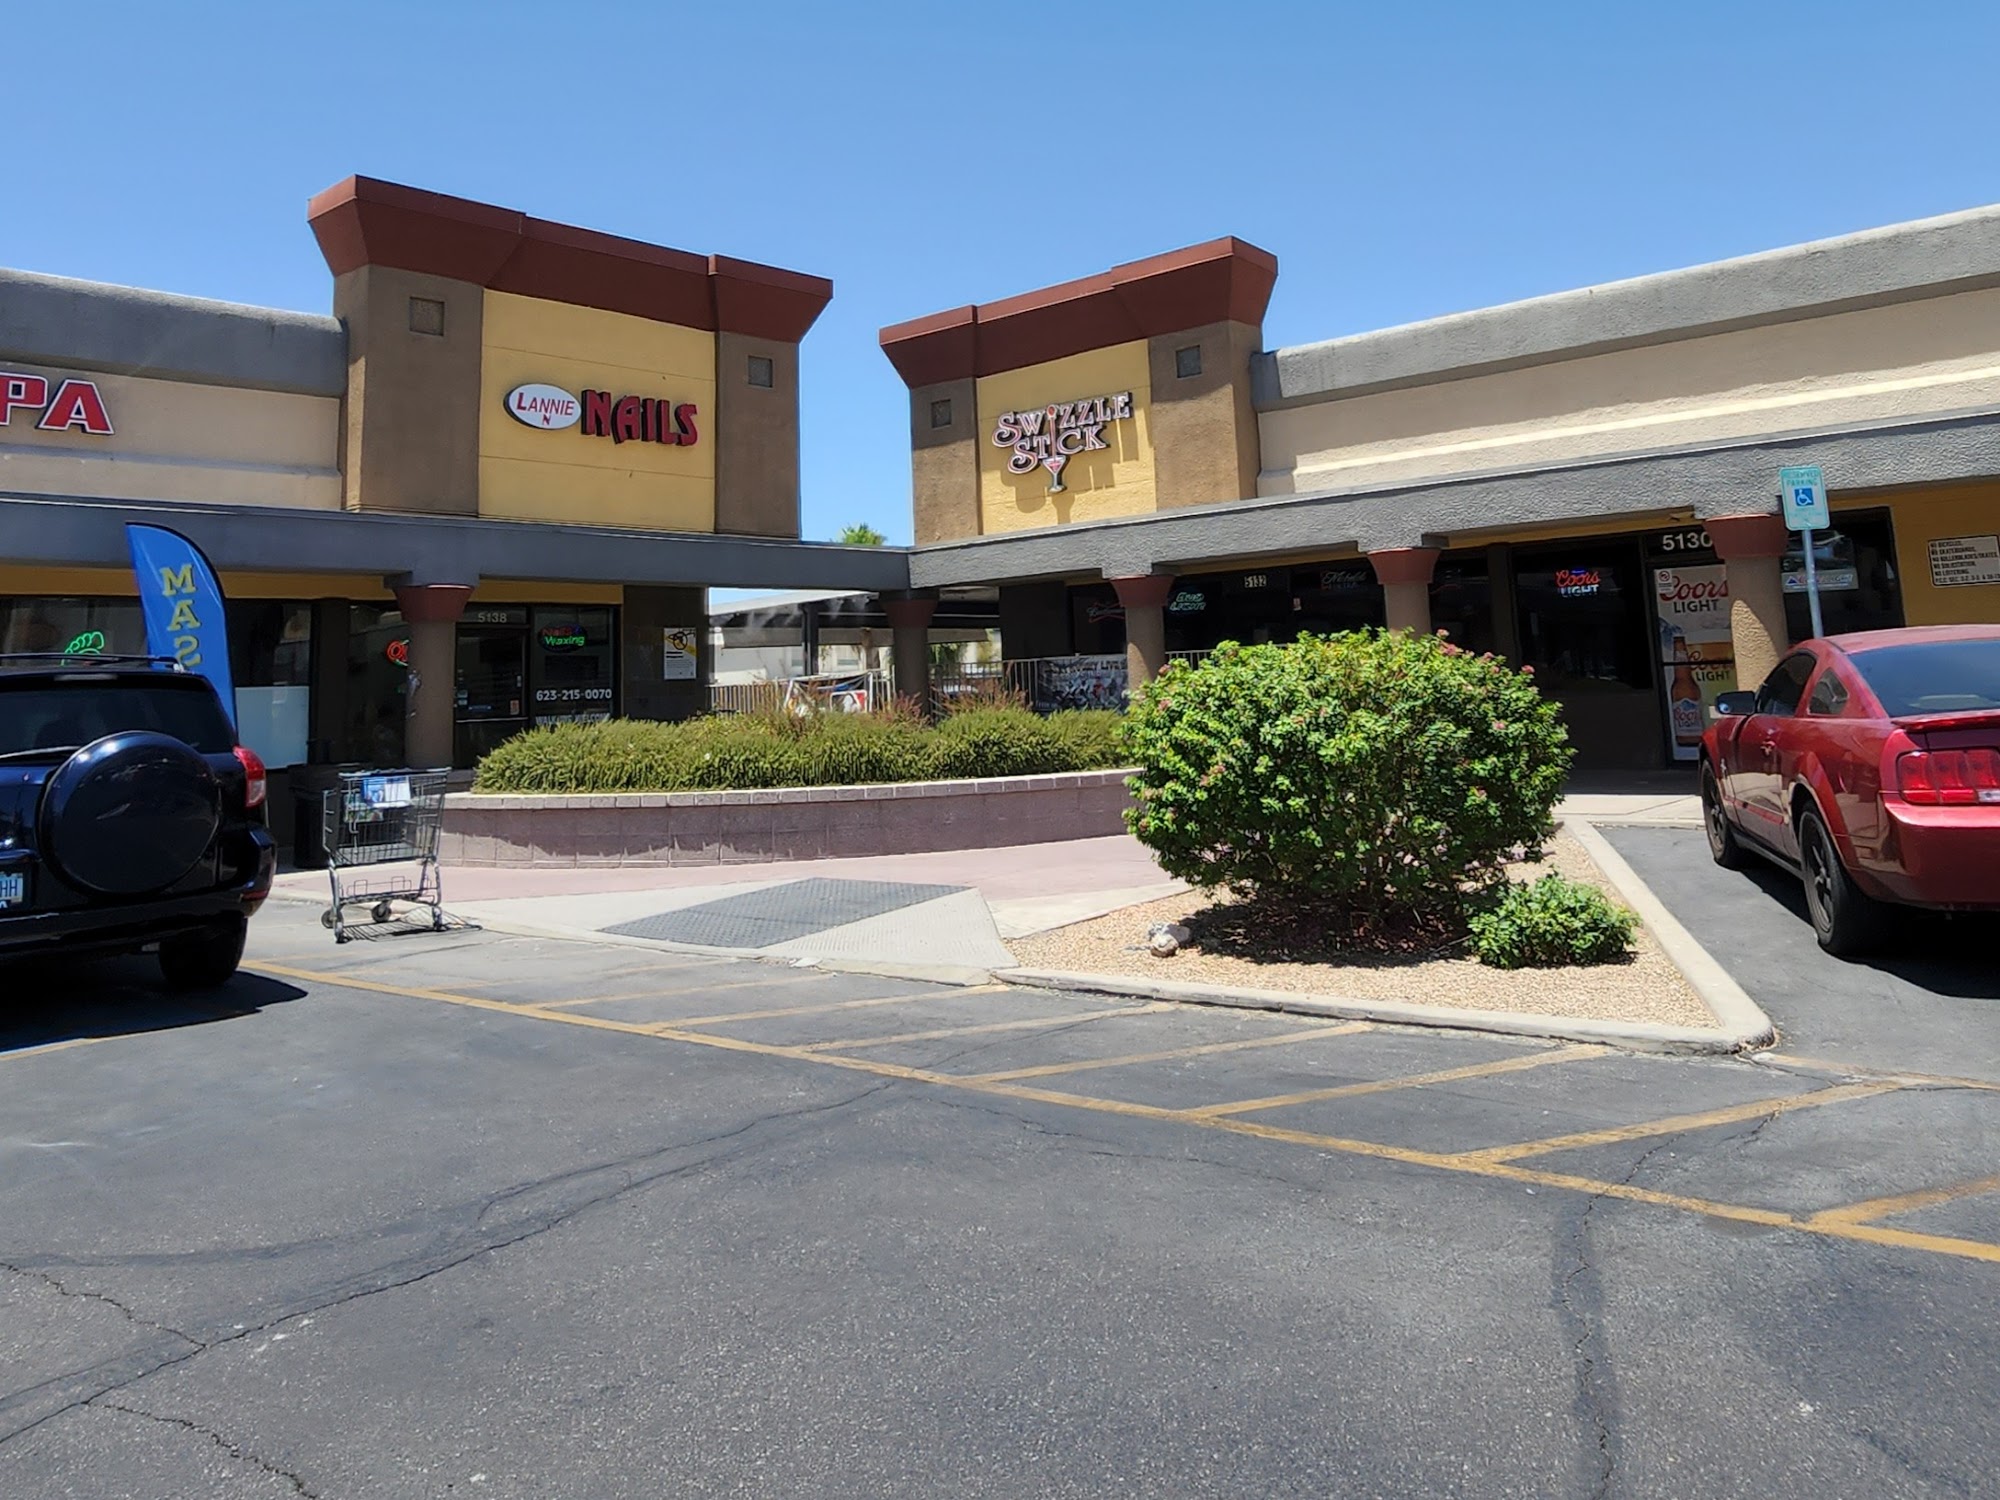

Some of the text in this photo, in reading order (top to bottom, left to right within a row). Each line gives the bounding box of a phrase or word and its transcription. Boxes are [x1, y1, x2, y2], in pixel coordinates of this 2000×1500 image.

[516, 392, 575, 416] LANNIE
[581, 389, 699, 446] NAILS
[992, 392, 1132, 447] SWIZZLE
[1007, 424, 1109, 474] STICK
[1662, 531, 1713, 551] 5130
[1556, 569, 1600, 587] Coors
[1660, 575, 1729, 602] Coors
[1673, 599, 1719, 613] LIGHT
[478, 612, 508, 624] 5138
[544, 635, 586, 647] Waxing
[1695, 670, 1731, 682] LIGHT
[536, 689, 613, 701] 623-215-0070
